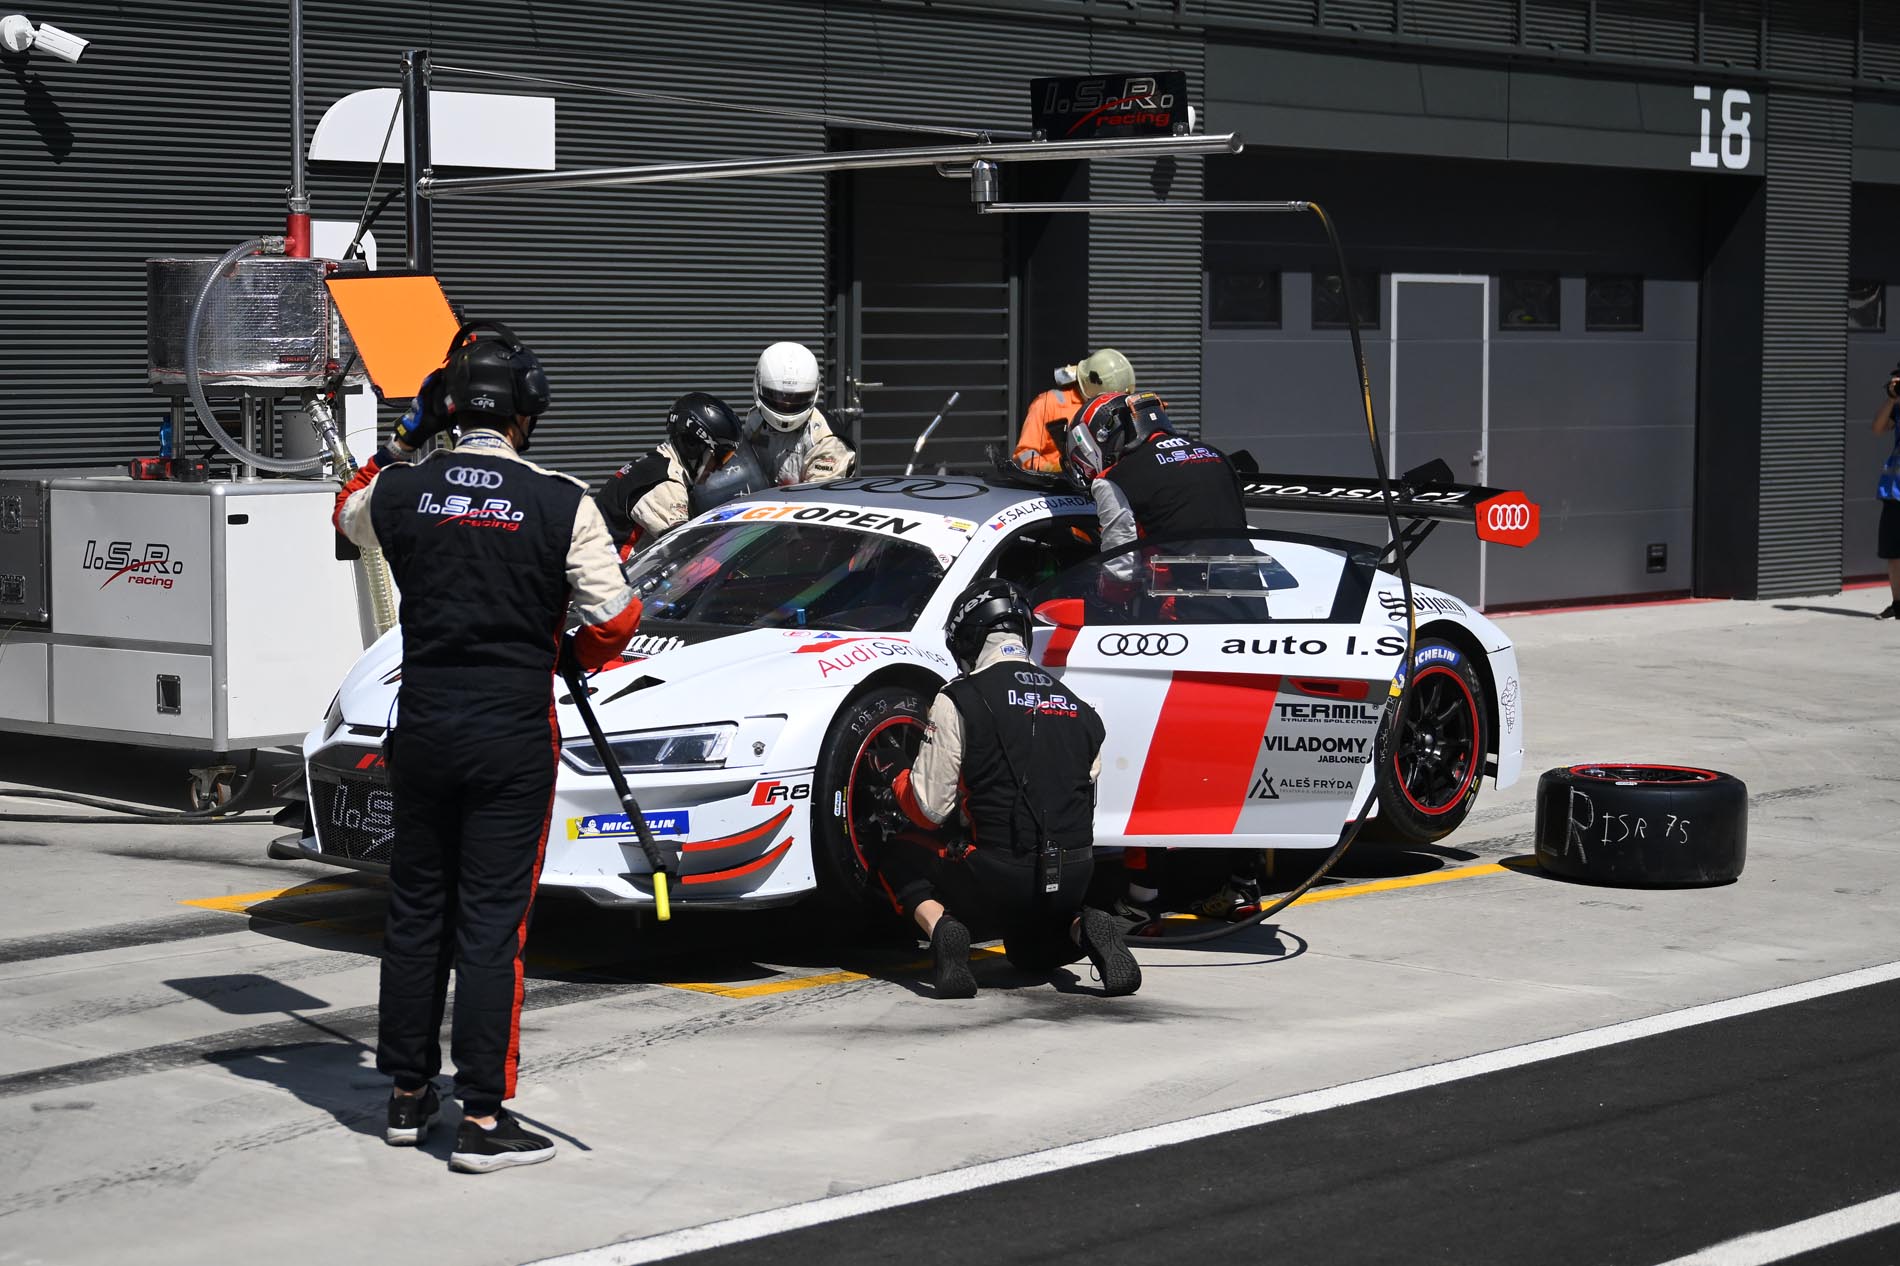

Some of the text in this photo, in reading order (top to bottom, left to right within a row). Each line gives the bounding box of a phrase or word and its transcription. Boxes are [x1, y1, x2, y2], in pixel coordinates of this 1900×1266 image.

[1096, 112, 1170, 127] racing
[1691, 85, 1751, 169] 18
[459, 519, 521, 531] racing
[128, 575, 174, 589] racing
[1221, 636, 1328, 655] auto
[1414, 648, 1456, 667] ICHELIN
[1275, 703, 1378, 720] TERMIL
[1264, 735, 1367, 753] VILADOMY
[1317, 755, 1367, 764] JABLONEC
[1280, 777, 1354, 789] ALEŠ FRÝDA
[767, 784, 809, 802] R8
[602, 819, 676, 831] MICLIN
[1602, 812, 1648, 846] ISR
